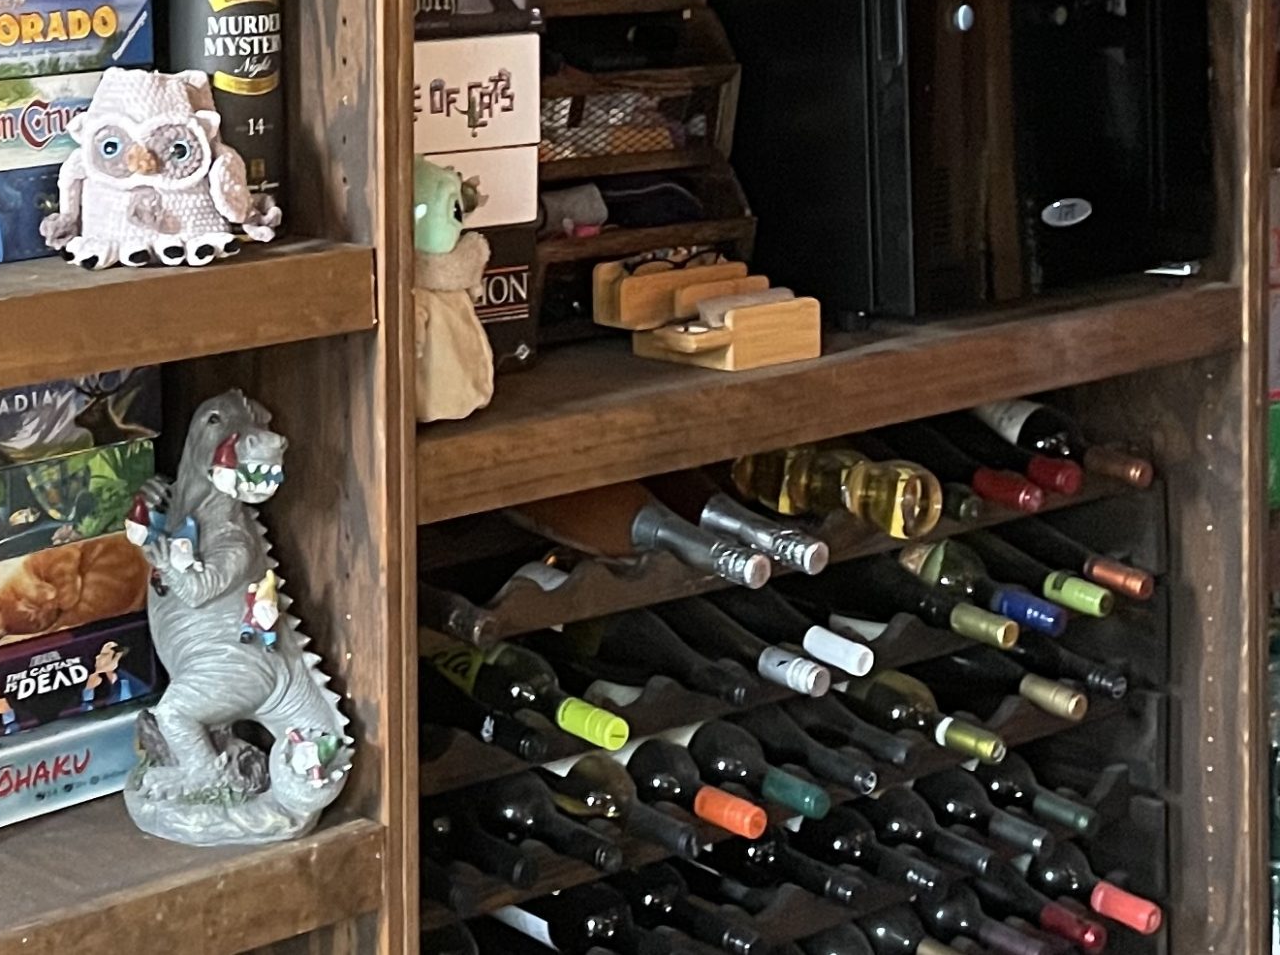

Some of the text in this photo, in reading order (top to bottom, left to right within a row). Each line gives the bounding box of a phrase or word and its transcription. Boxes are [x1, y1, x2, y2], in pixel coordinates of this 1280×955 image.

[207, 12, 281, 38] MURDE
[203, 35, 281, 58] MYSTER
[429, 78, 462, 116] OF
[20, 99, 88, 149] Cru
[246, 117, 266, 137] 14
[481, 272, 529, 306] ION
[17, 664, 89, 701] DEAD
